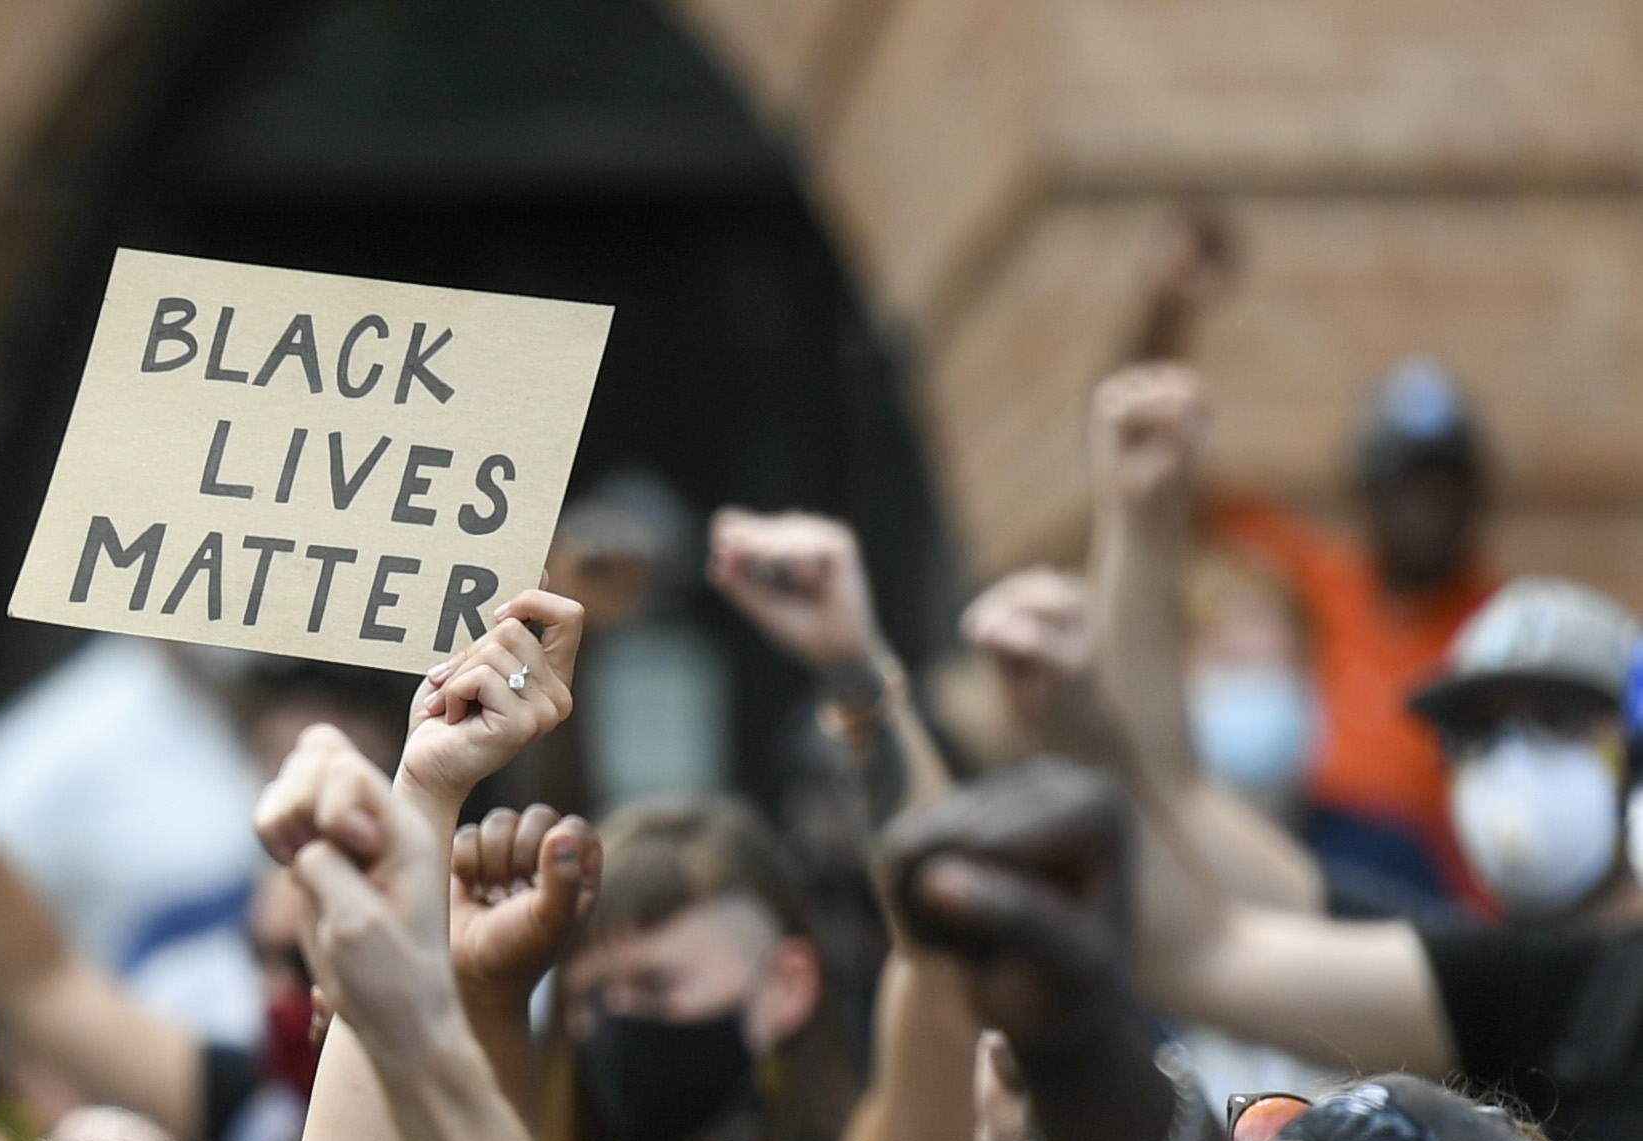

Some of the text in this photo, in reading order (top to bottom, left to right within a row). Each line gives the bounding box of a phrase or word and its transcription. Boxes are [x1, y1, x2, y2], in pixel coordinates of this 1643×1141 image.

[141, 297, 455, 404] BLACK
[199, 420, 516, 536] LIVES
[69, 515, 500, 654] MATTER
